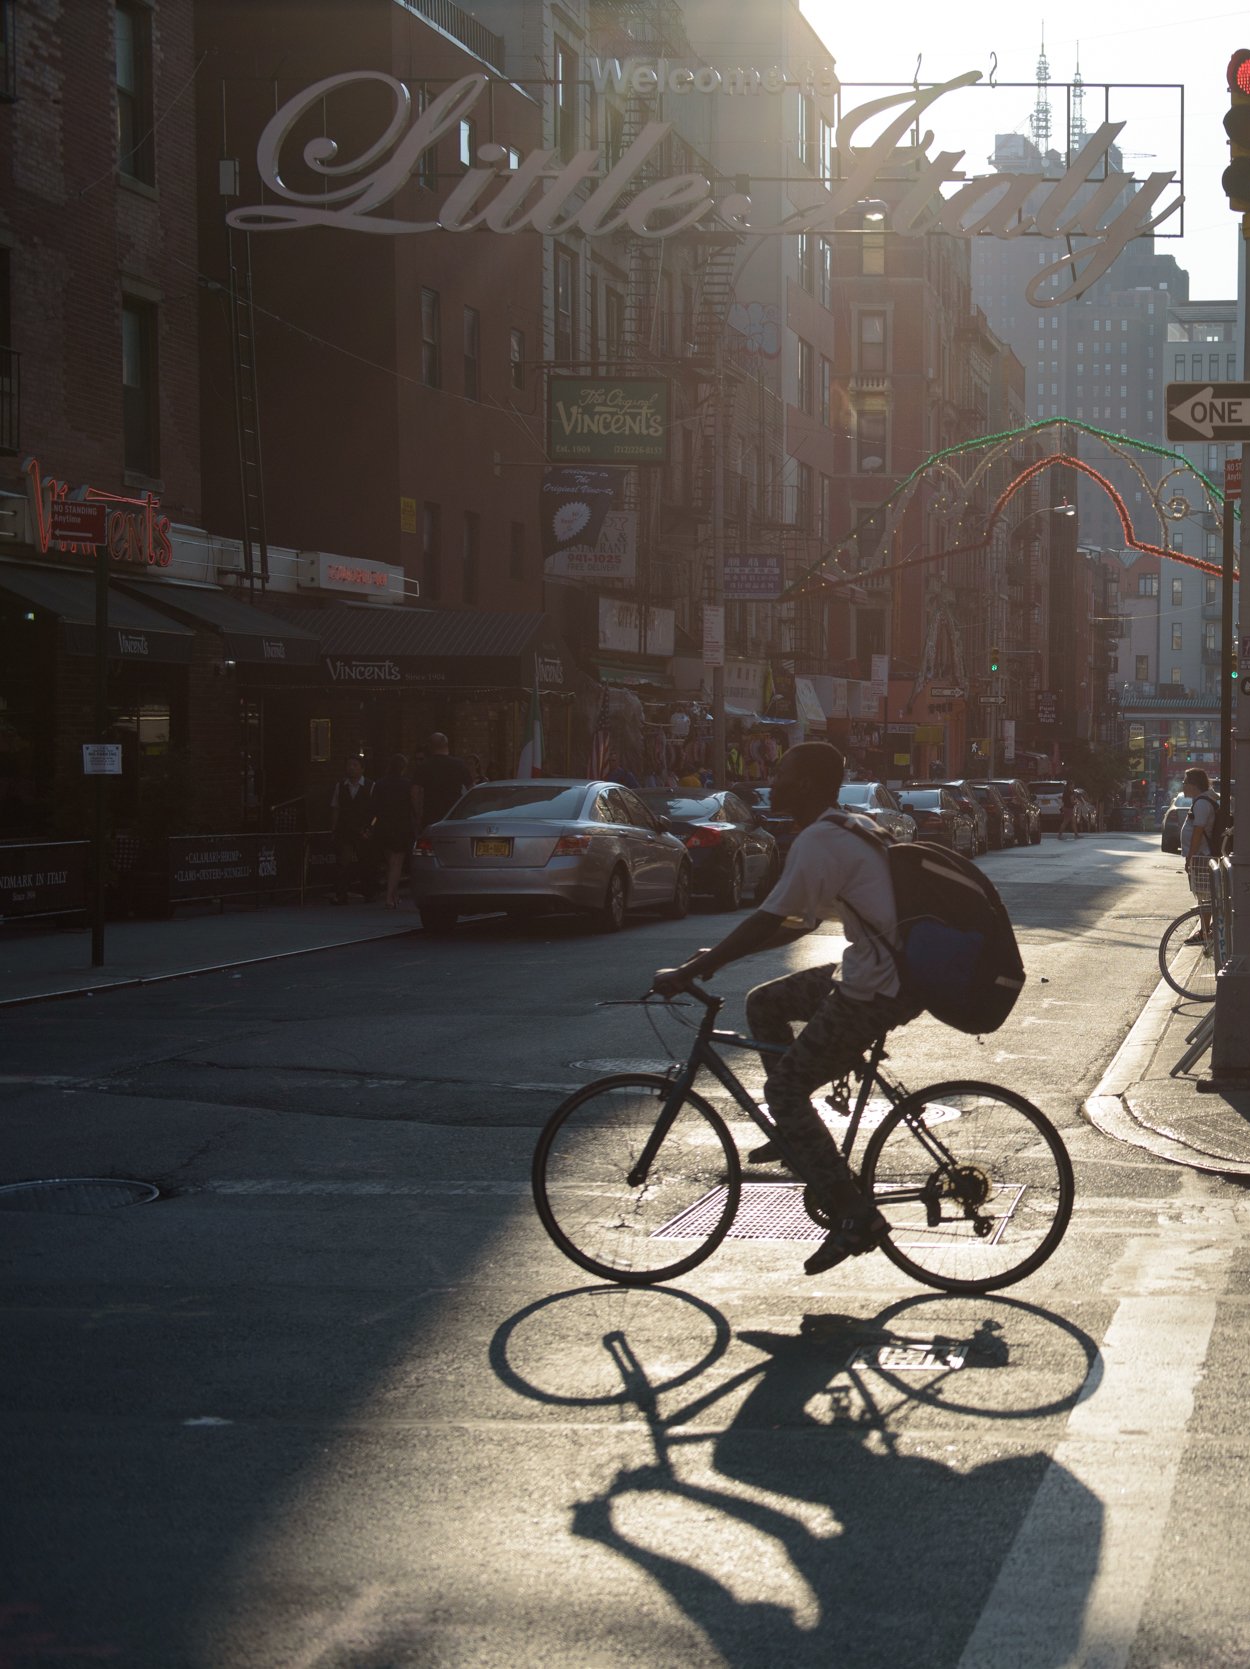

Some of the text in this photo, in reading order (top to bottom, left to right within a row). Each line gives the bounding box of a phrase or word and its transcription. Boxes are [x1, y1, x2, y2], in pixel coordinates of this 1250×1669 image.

[586, 57, 838, 97] Welcome to
[226, 70, 1187, 308] Little Italy
[579, 388, 658, 415] The Original
[1190, 401, 1243, 423] ONE
[1227, 463, 1235, 472] NO
[53, 505, 98, 515] NO STANDING
[54, 514, 82, 524] Anytime
[568, 553, 622, 564] 941-1025
[35, 872, 45, 886] IN
[47, 870, 68, 885] ITALY
